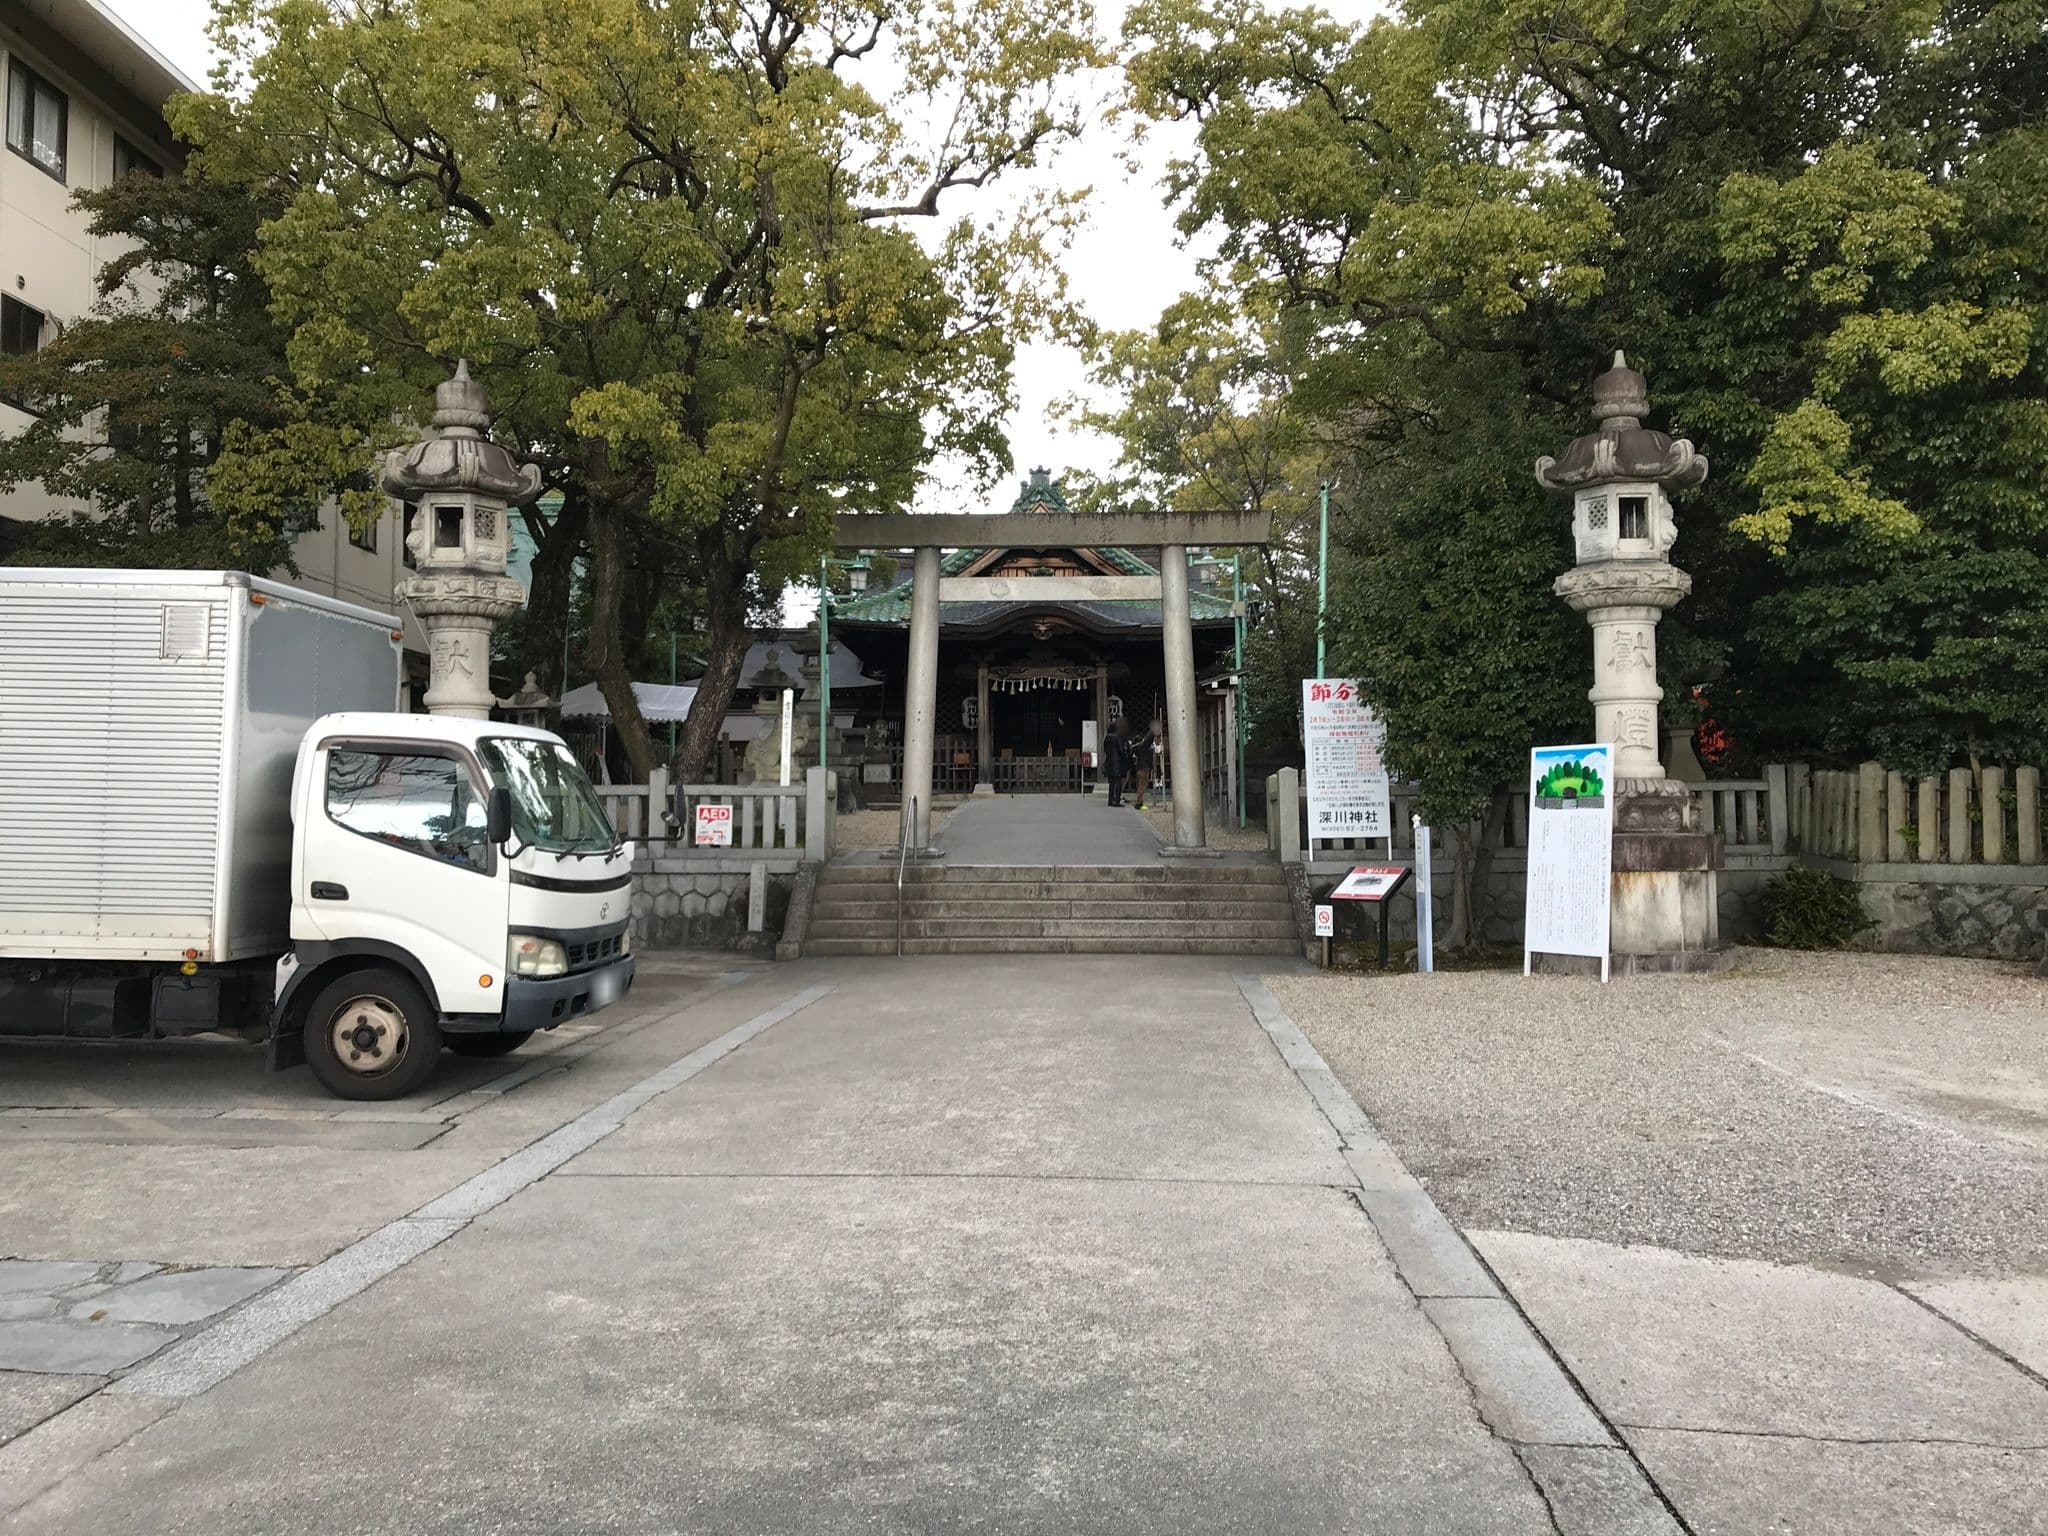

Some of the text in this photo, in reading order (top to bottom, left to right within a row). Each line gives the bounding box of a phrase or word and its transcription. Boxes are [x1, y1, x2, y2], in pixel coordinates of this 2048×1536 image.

[701, 808, 729, 819] AED
[1319, 810, 1379, 823] 深川神社
